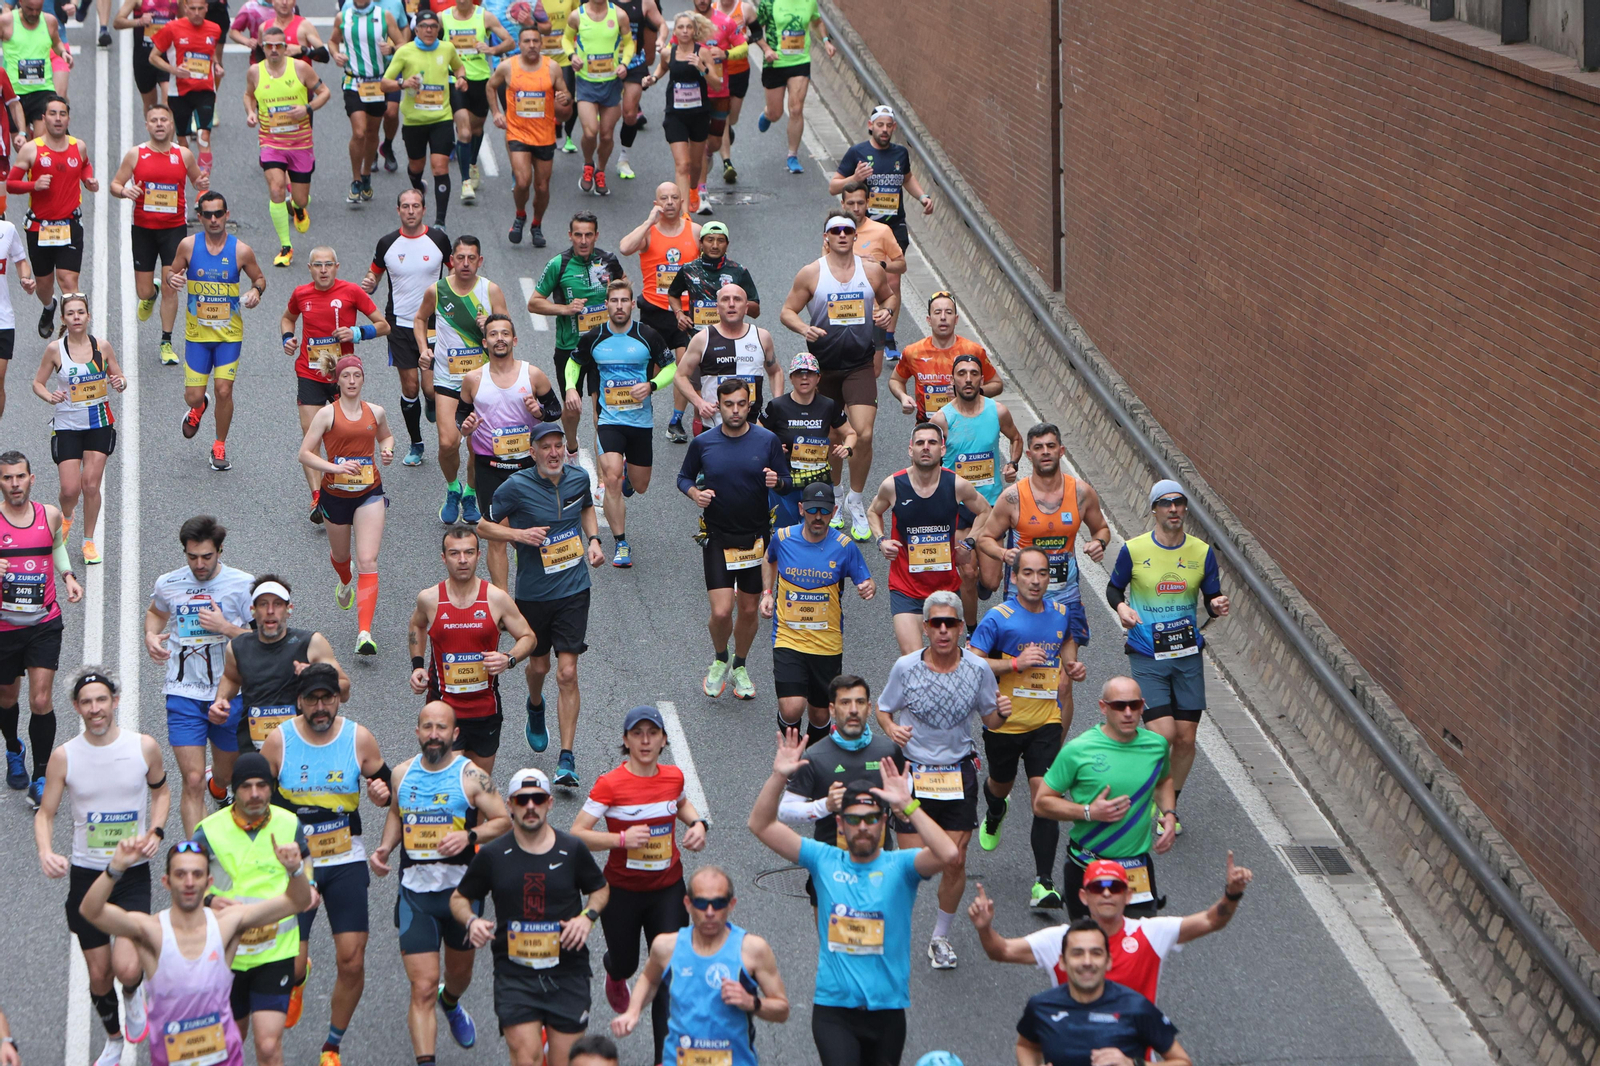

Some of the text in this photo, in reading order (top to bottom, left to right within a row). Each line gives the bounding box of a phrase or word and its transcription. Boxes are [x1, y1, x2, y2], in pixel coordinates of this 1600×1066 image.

[277, 95, 299, 103] BIRDMAN
[459, 348, 480, 356] ZURICH
[716, 355, 754, 364] PONTYPRIDD
[82, 372, 103, 382] ZURICH
[917, 372, 952, 383] Running
[788, 419, 823, 427] TRIBOOST
[505, 426, 526, 435] ZURICH
[806, 436, 827, 444] ZURICH
[968, 452, 991, 461] ZURICH
[907, 525, 951, 535] FUENTERREBOLLO
[552, 530, 575, 543] ZURICH
[922, 535, 945, 543] ZURICH
[922, 547, 936, 555] 4753
[551, 552, 578, 565] ABDERAZAK
[739, 553, 757, 561] SANTOS
[785, 566, 833, 580] agustinos
[17, 574, 43, 582] ZURICH
[1159, 583, 1185, 591] El Llano
[800, 594, 825, 602] ZURICH
[1143, 604, 1164, 613] LLANO
[443, 622, 483, 630] PUROSANGUE
[1166, 618, 1190, 629] ZURICH
[1167, 633, 1182, 642] 3474
[1169, 643, 1183, 651] RAFA
[458, 653, 484, 662] ZURICH
[458, 666, 474, 675] 6253
[1030, 672, 1046, 680] 4079
[263, 706, 291, 716] ZURICH
[104, 813, 134, 823] ZURICH
[419, 815, 447, 824] ZURICH
[317, 820, 345, 833] ZURICH
[650, 826, 669, 836] URICH
[524, 924, 554, 932] ZURICH
[694, 1039, 727, 1049] ZURICH
